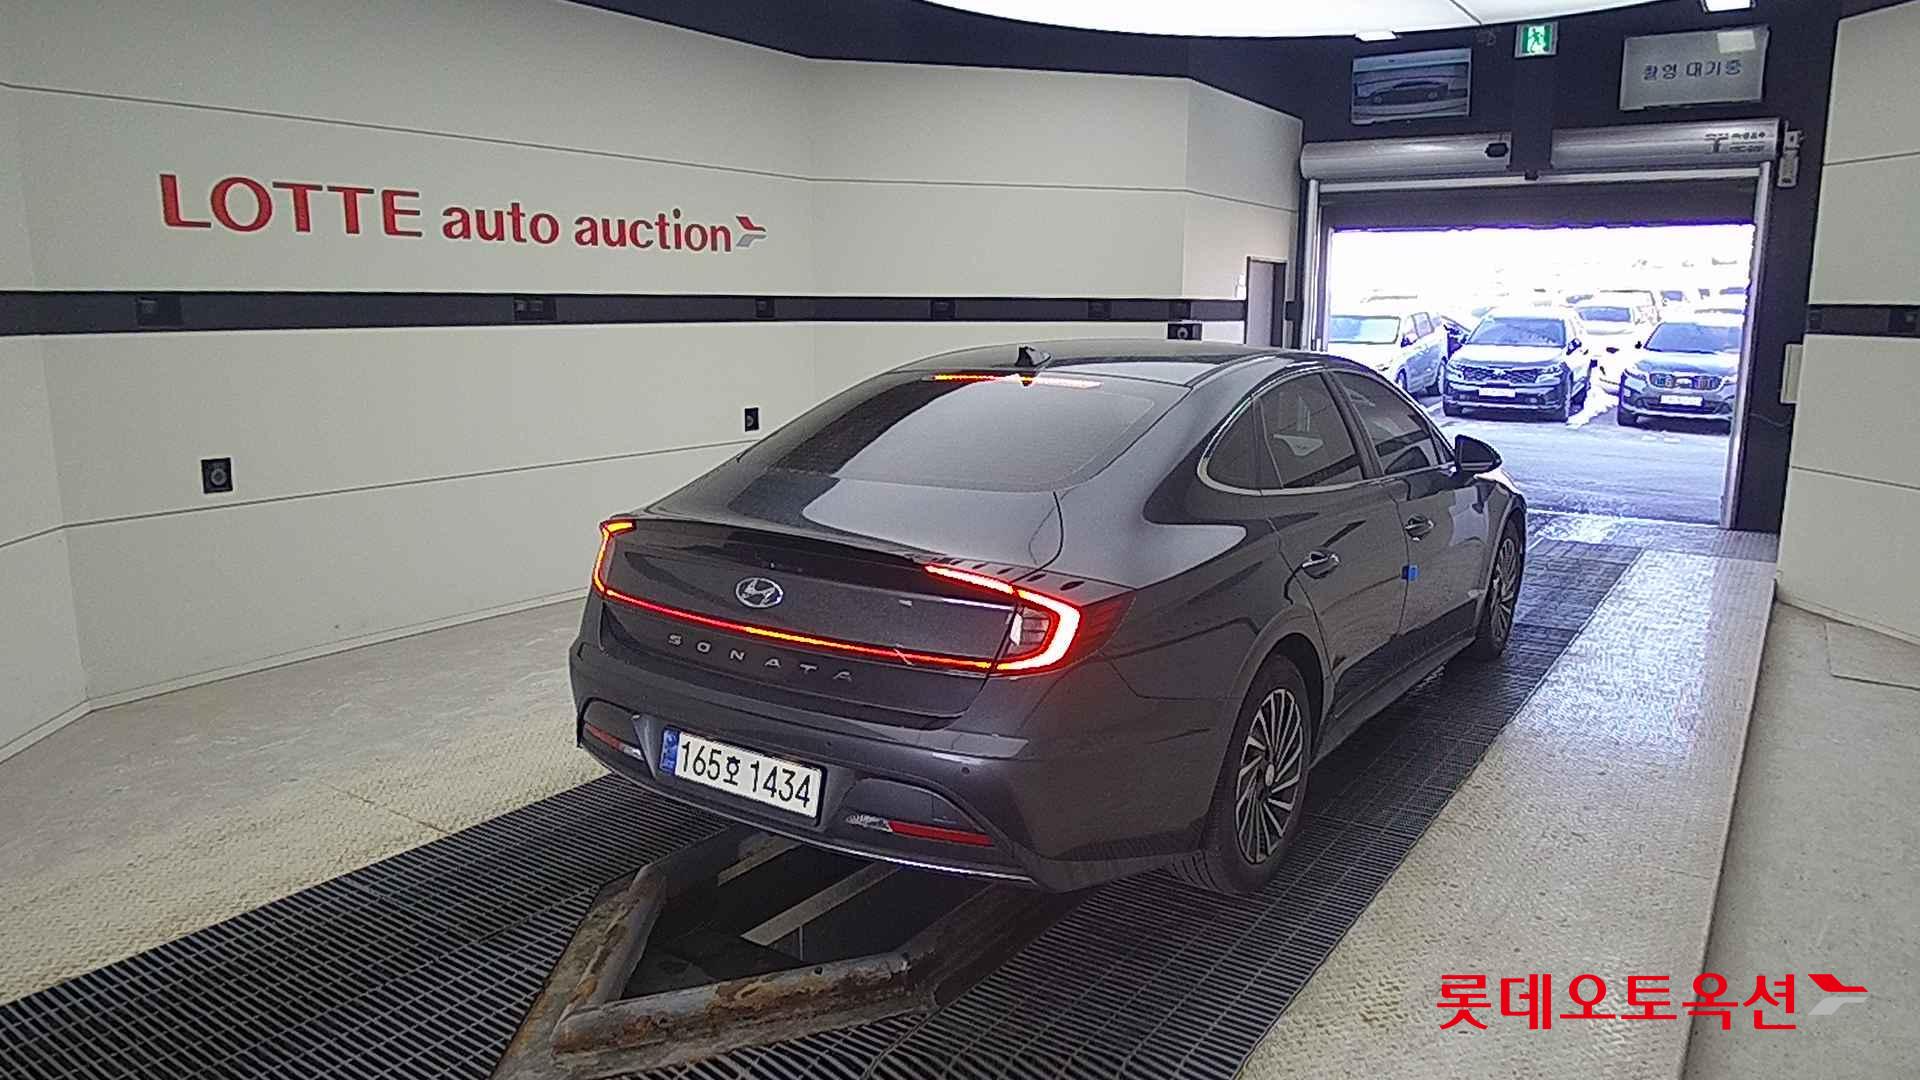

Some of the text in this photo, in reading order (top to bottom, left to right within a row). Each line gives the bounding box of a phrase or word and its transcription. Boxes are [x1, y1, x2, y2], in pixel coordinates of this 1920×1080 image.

[159, 173, 733, 252] LOTTE auto auction
[667, 633, 853, 682] SONATA
[681, 740, 811, 808] 165호 1434
